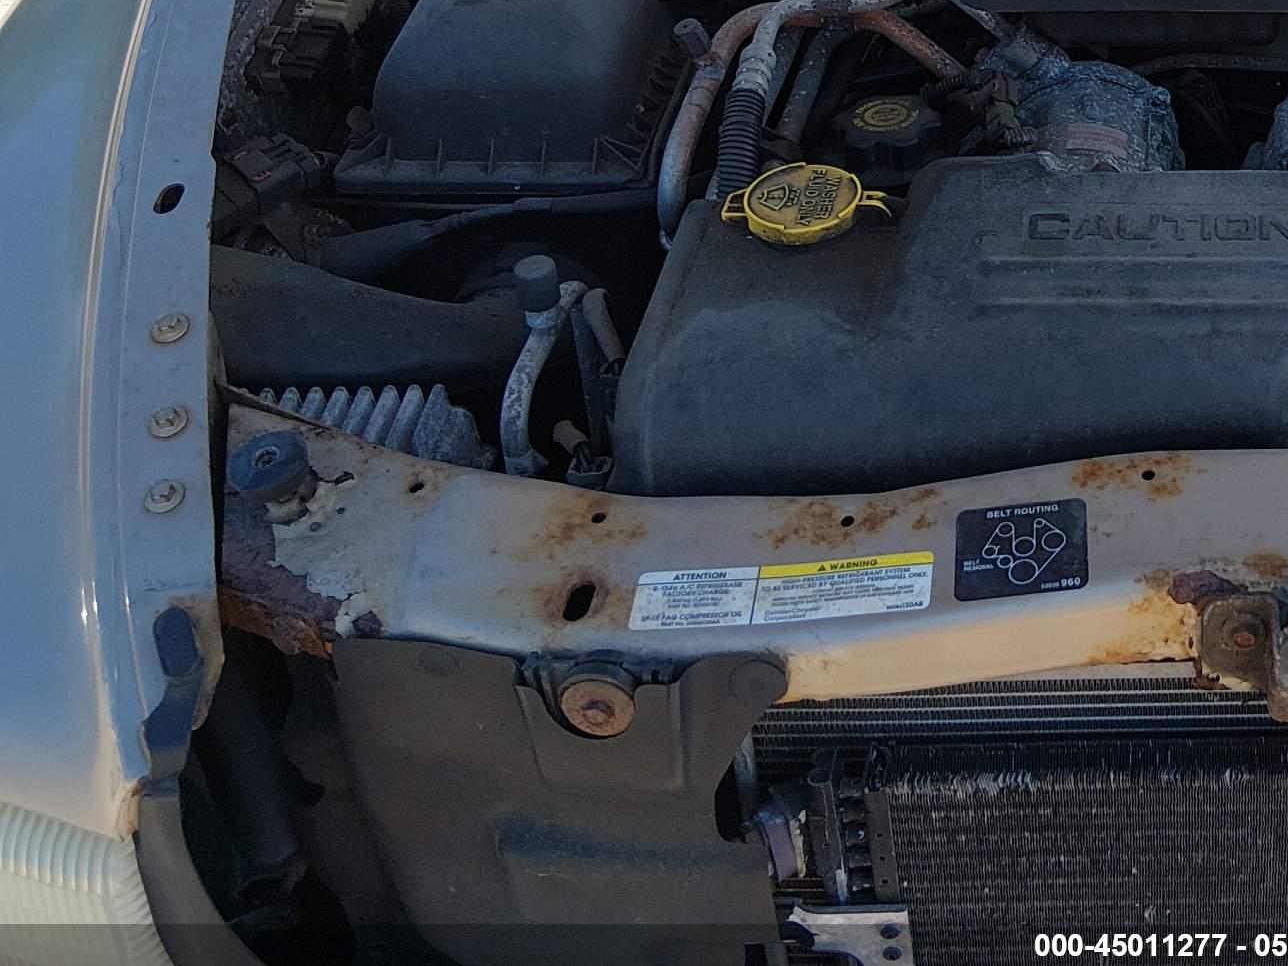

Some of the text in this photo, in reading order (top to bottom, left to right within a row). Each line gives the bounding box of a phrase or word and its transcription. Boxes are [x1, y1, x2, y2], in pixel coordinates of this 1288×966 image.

[796, 169, 828, 226] FLUID ONLY
[816, 176, 842, 220] WASHER
[986, 504, 1059, 519] BELT ROUTING
[829, 559, 878, 571] WARNING
[673, 572, 727, 581] ATTENTION
[829, 577, 865, 587] QUALIFIED
[866, 574, 906, 584] PERSONNEL
[1060, 577, 1081, 587] 960
[679, 583, 695, 591] A/C
[679, 611, 729, 620] COMPRESSOR
